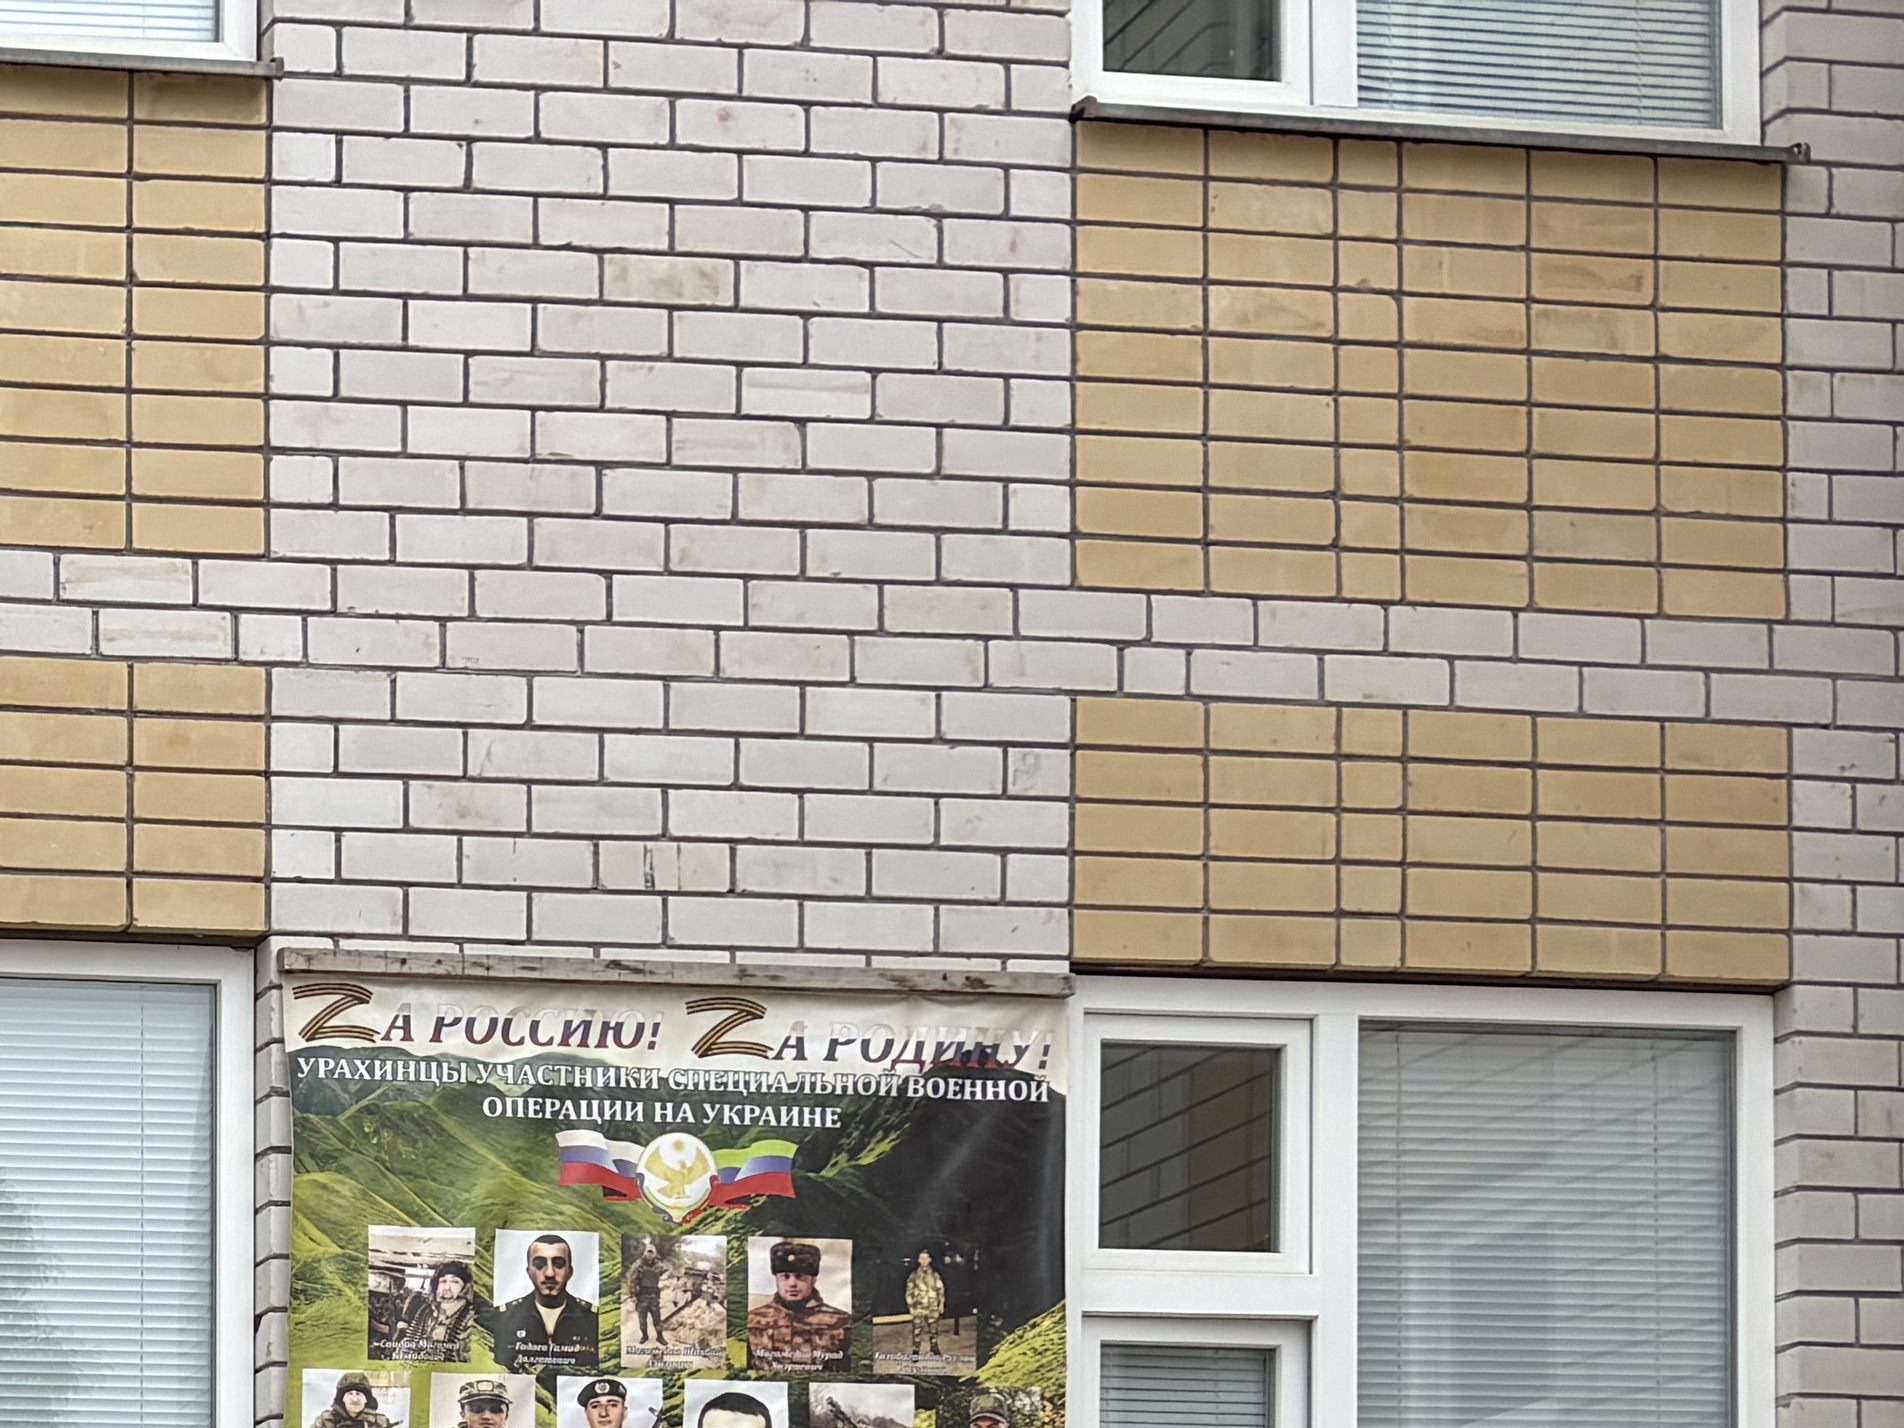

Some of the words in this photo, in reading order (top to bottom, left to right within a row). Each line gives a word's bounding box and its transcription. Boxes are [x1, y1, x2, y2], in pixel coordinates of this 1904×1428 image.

[429, 1003, 664, 1051] РОССИЮ!
[823, 1021, 1055, 1074] РОДИНУ!
[296, 1057, 467, 1087] УРАХИНЦЫ
[475, 1062, 659, 1089] УЧАСТНИКИ
[667, 1067, 903, 1098] СПЕЦИАЛЬНОЙ
[906, 1073, 1050, 1103] ВОЕННОЙ
[481, 1096, 644, 1124] ОПЕРАЦИИ
[654, 1102, 695, 1124] НА
[701, 1102, 842, 1129] УКРАИНЕ
